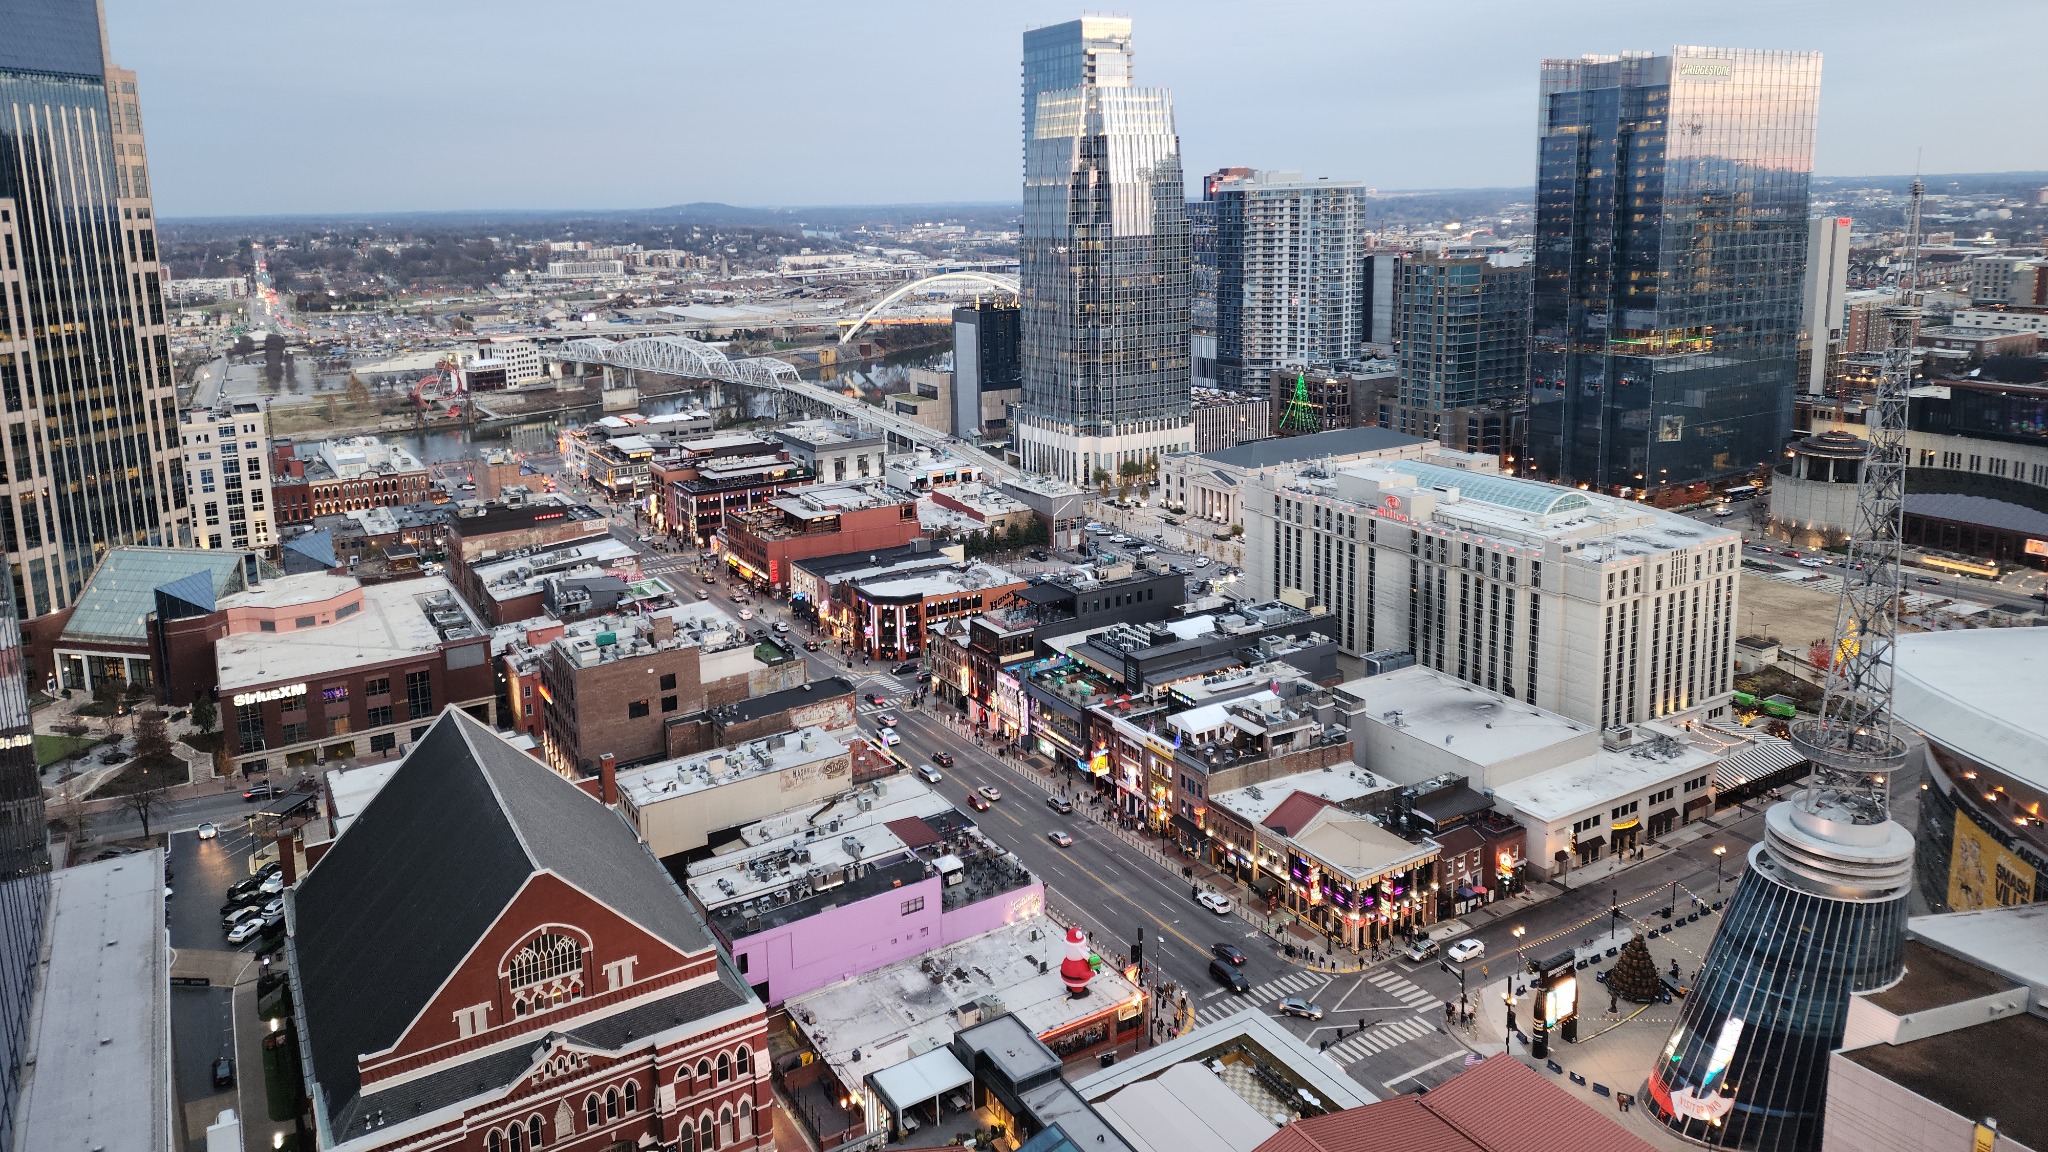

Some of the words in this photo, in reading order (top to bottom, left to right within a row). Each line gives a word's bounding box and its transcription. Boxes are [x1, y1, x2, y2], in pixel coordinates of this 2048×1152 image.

[1680, 63, 1730, 76] BRIDGESTONE
[1377, 506, 1409, 523] Hilton
[233, 683, 307, 707] SiriusXM
[1996, 863, 2030, 900] SMASH
